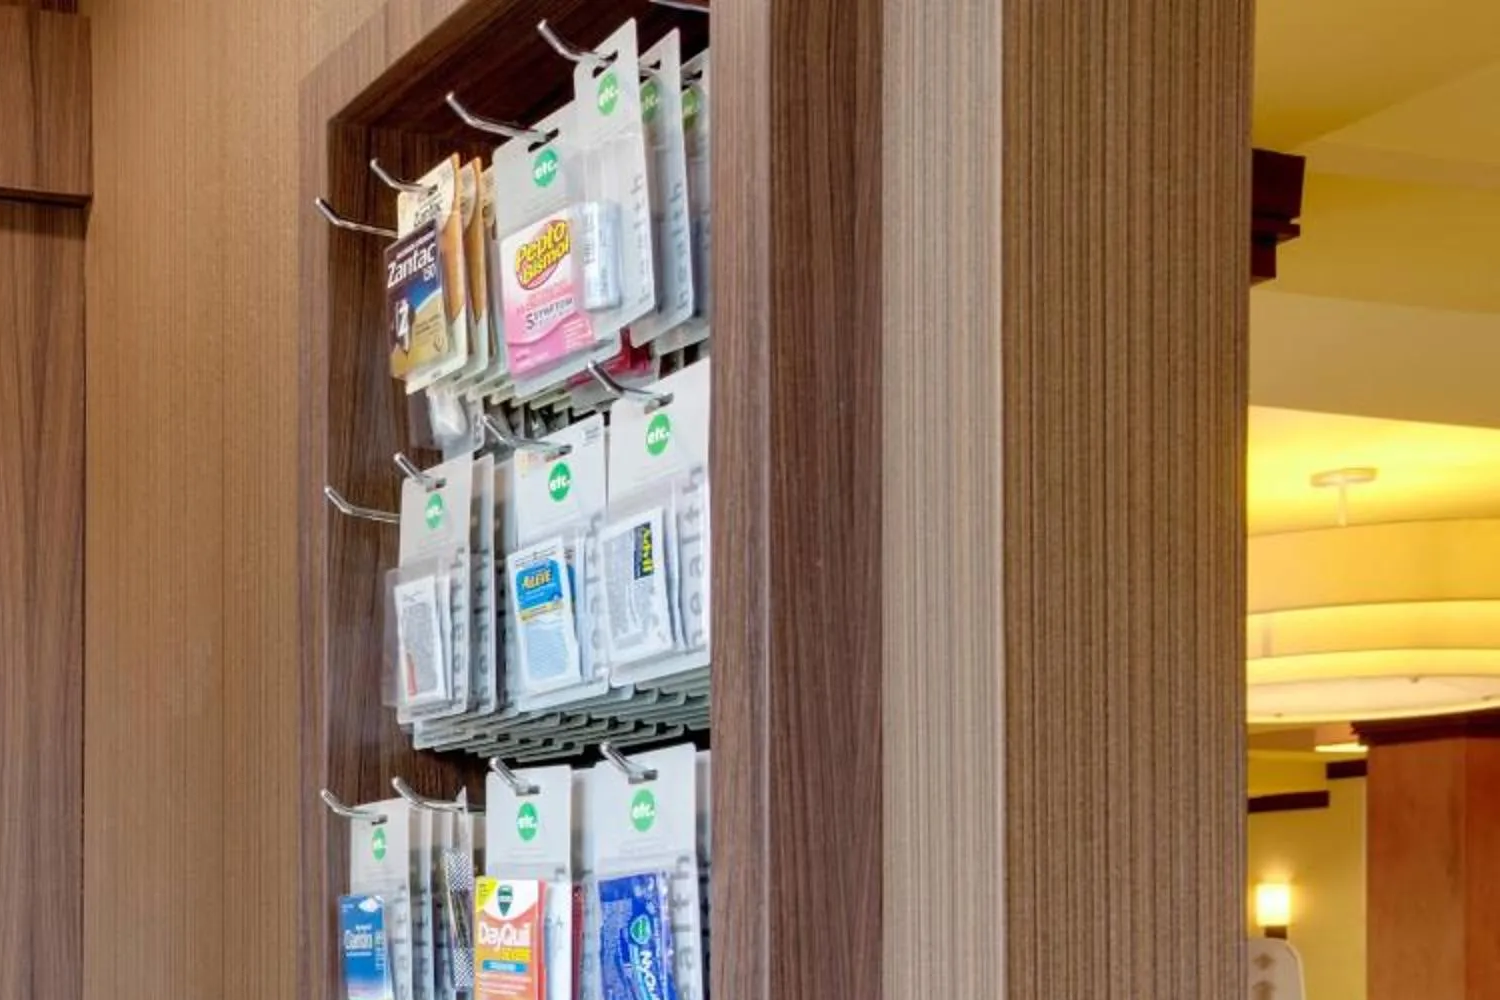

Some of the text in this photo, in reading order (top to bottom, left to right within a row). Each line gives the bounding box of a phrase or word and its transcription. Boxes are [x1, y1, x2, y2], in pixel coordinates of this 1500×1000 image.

[516, 219, 569, 268] Pepto
[387, 242, 437, 289] Zantac
[647, 426, 670, 444] etc.
[550, 476, 571, 491] etc.
[632, 803, 655, 820] etc.
